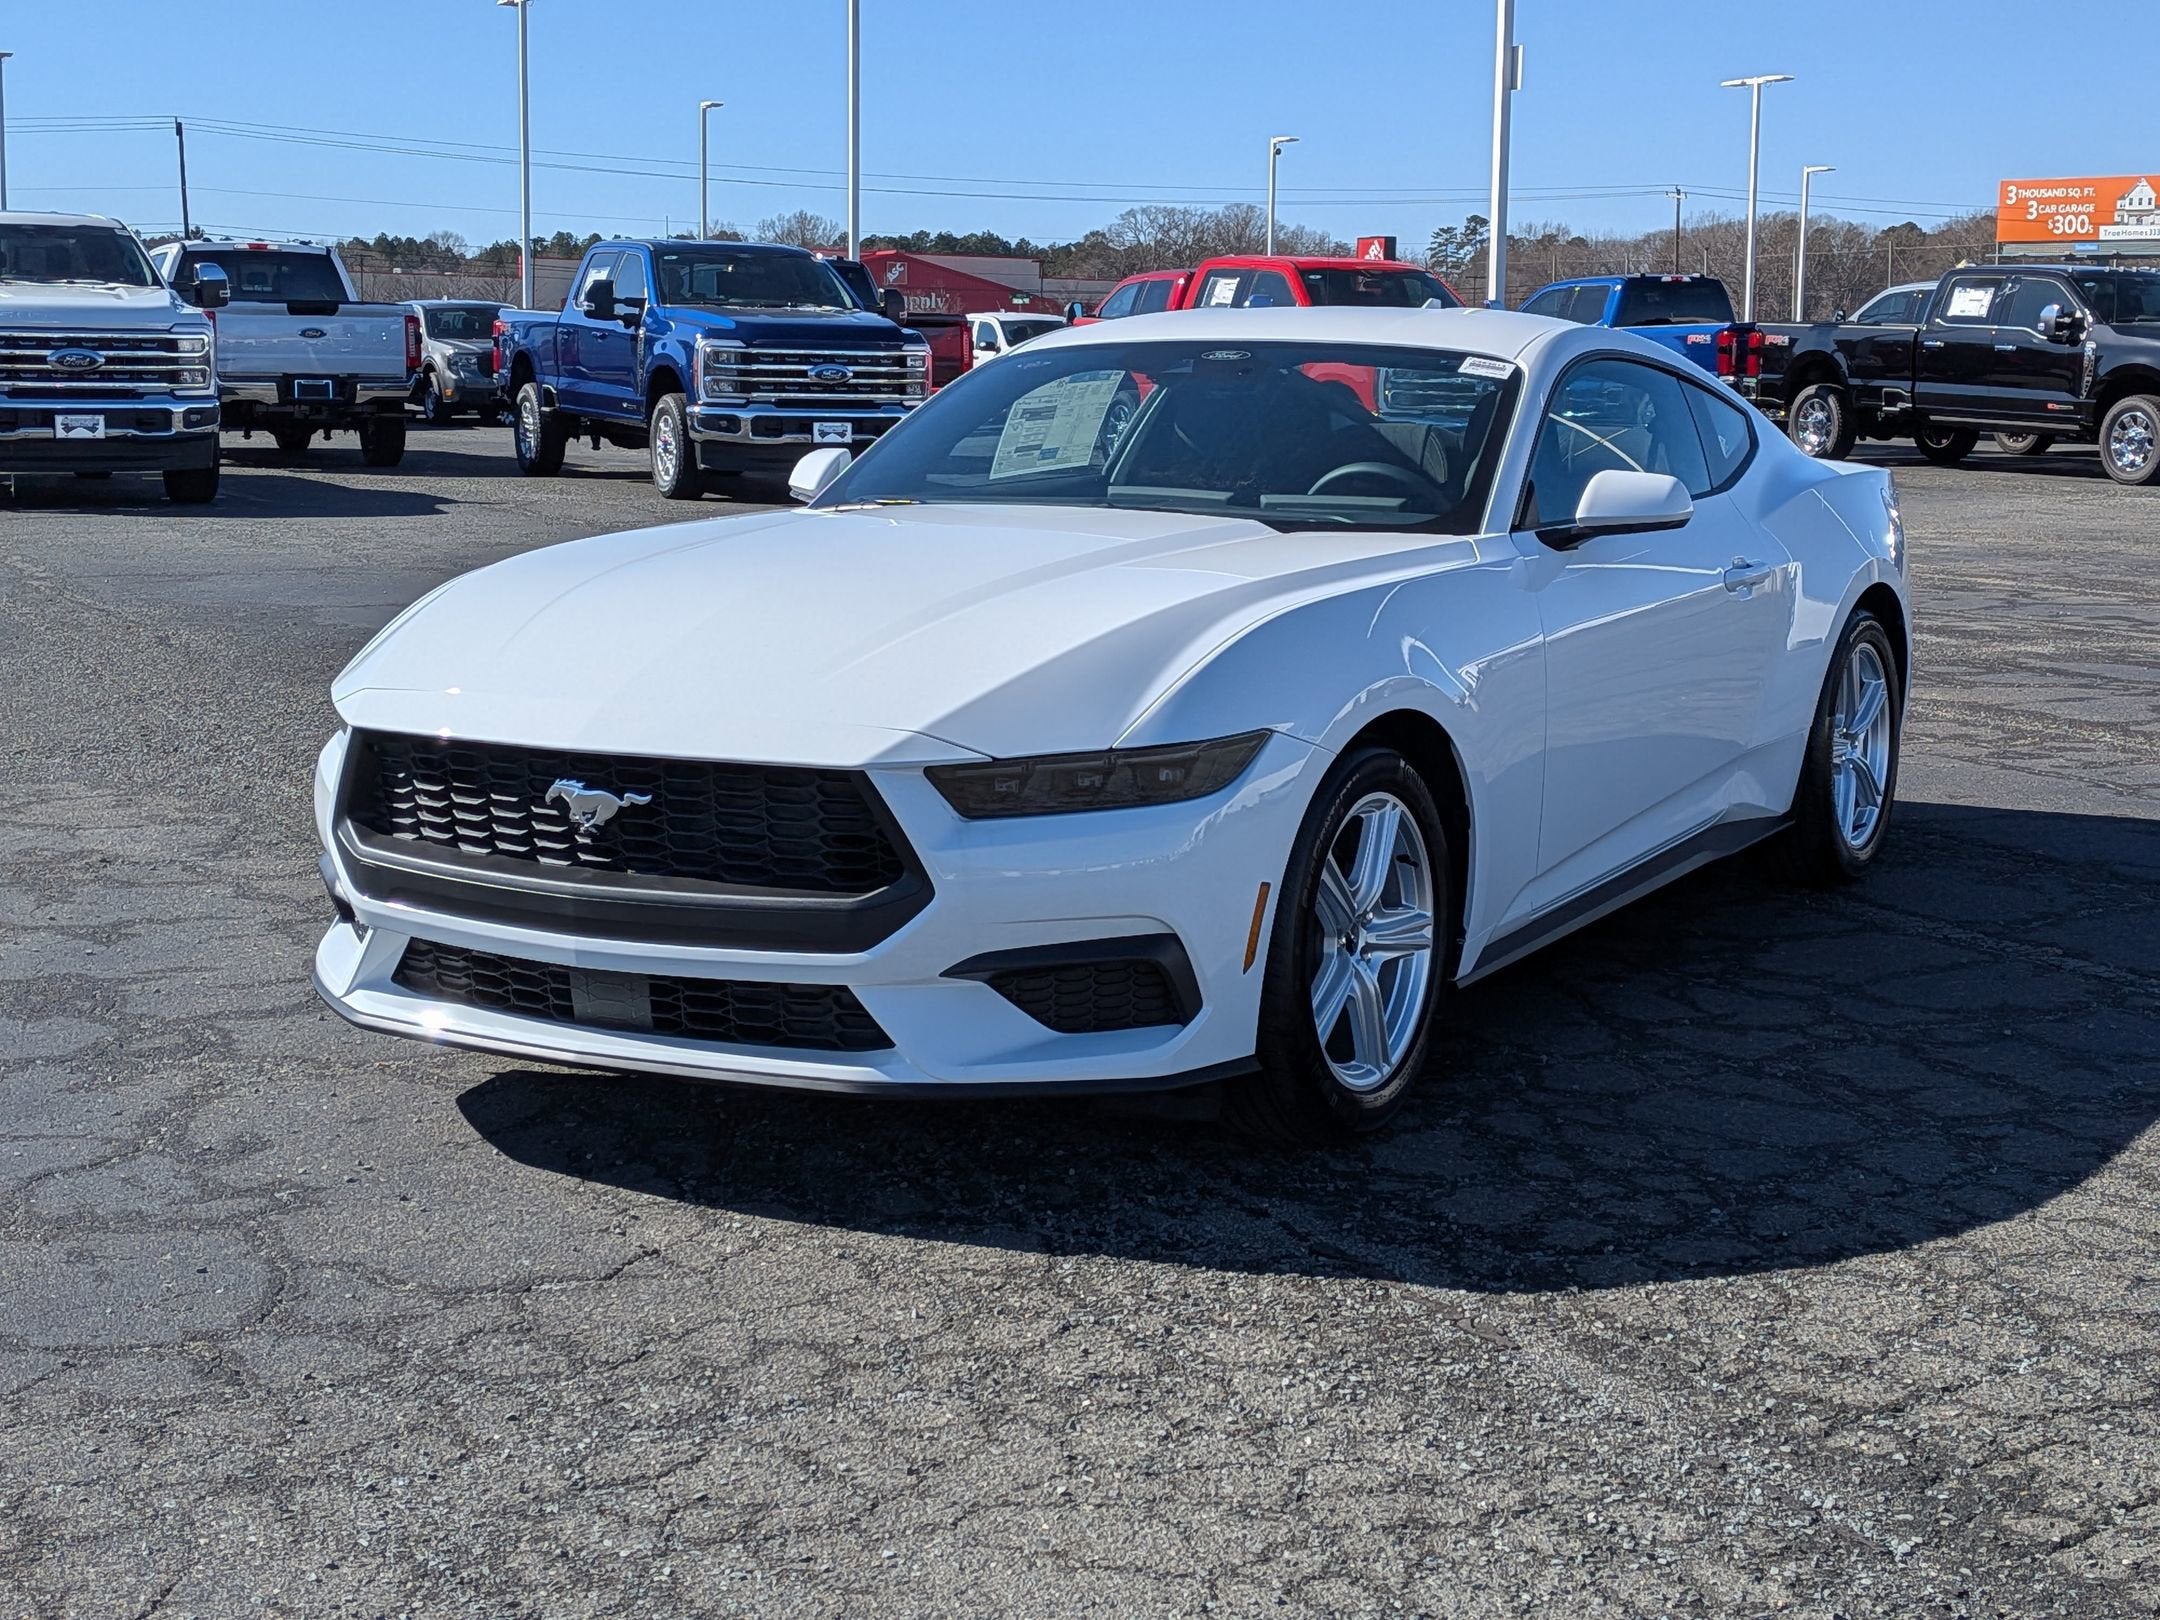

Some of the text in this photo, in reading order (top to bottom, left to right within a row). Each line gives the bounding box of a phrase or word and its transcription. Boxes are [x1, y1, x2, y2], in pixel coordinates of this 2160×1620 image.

[2006, 185, 2096, 205] 3 THOUSAND SQ. FT.
[2026, 200, 2096, 220] 3 CAR GARAGE
[2047, 214, 2094, 235] $300s
